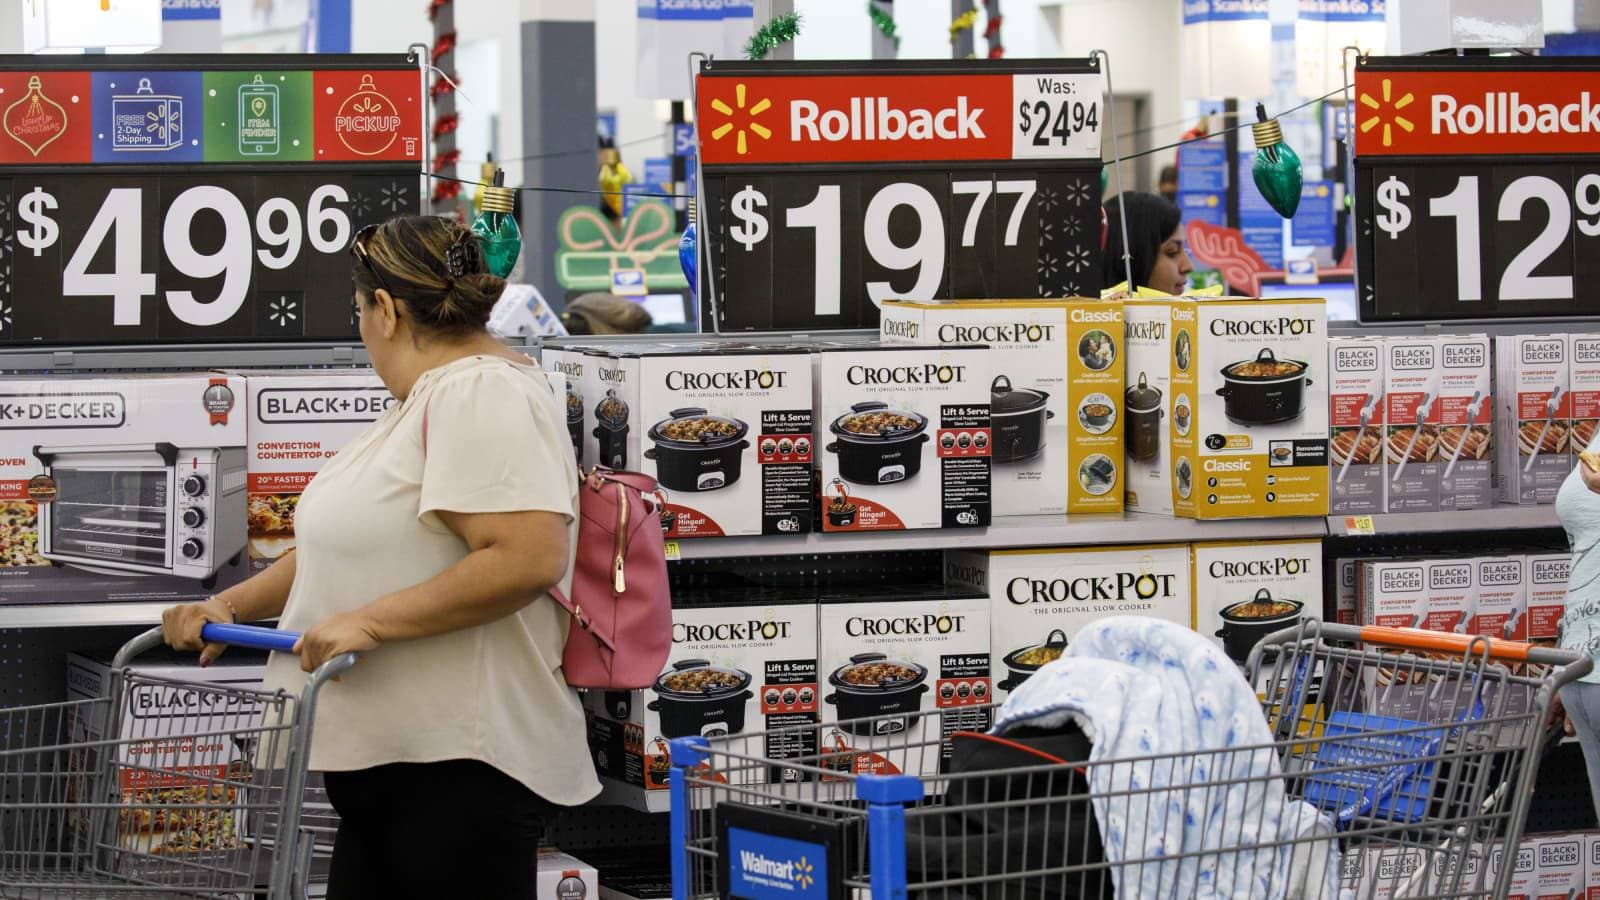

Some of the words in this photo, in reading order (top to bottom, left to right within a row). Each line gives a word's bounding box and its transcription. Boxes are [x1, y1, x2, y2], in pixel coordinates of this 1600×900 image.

[1037, 78, 1076, 94] Was:
[1431, 92, 1600, 135] Rollback
[116, 114, 145, 126] FREE
[790, 96, 985, 141] Rollback
[247, 119, 270, 128] ITEM
[335, 116, 401, 132] PICKUP
[117, 126, 141, 135] 2-Day
[241, 128, 277, 137] FINDER
[117, 135, 152, 144] Shipping
[1071, 308, 1122, 323] Classic
[1446, 347, 1481, 356] BLACK+
[1525, 343, 1560, 352] BLACK+
[1339, 350, 1374, 359] BLACK+
[1395, 349, 1430, 358] BLACK+
[1525, 351, 1560, 360] DECKER
[1339, 359, 1374, 367] DECKER
[1395, 358, 1431, 366] DECKER
[1446, 356, 1481, 364] DECKER
[216, 388, 221, 400] 1
[943, 408, 958, 416] Lift
[959, 408, 966, 416] &
[967, 407, 989, 415] Serve
[763, 414, 779, 422] Lift
[780, 413, 787, 422] &
[788, 413, 811, 422] Serve
[257, 442, 320, 450] CONVECTION
[257, 451, 322, 459] COUNTERTOP
[1203, 458, 1252, 473] Classic
[1483, 565, 1517, 573] BLACK+
[1536, 563, 1570, 572] BLACK+
[1384, 571, 1419, 580] BLACK+
[1433, 568, 1467, 577] BLACK+
[1536, 571, 1570, 580] DECKER
[1433, 576, 1468, 585] DECKER
[1483, 573, 1518, 582] DECKER
[1384, 580, 1420, 588] DECKER
[1051, 606, 1090, 614] ORIGINAL
[1118, 603, 1152, 611] COOKER
[942, 658, 958, 666] Lift
[958, 657, 965, 665] &
[966, 657, 989, 665] Serve
[767, 664, 782, 672] Lift
[783, 663, 790, 671] &
[792, 663, 815, 671] Serve
[1542, 845, 1577, 855] BLACK+
[1542, 854, 1577, 863] DECKER
[740, 850, 794, 881] Walmart
